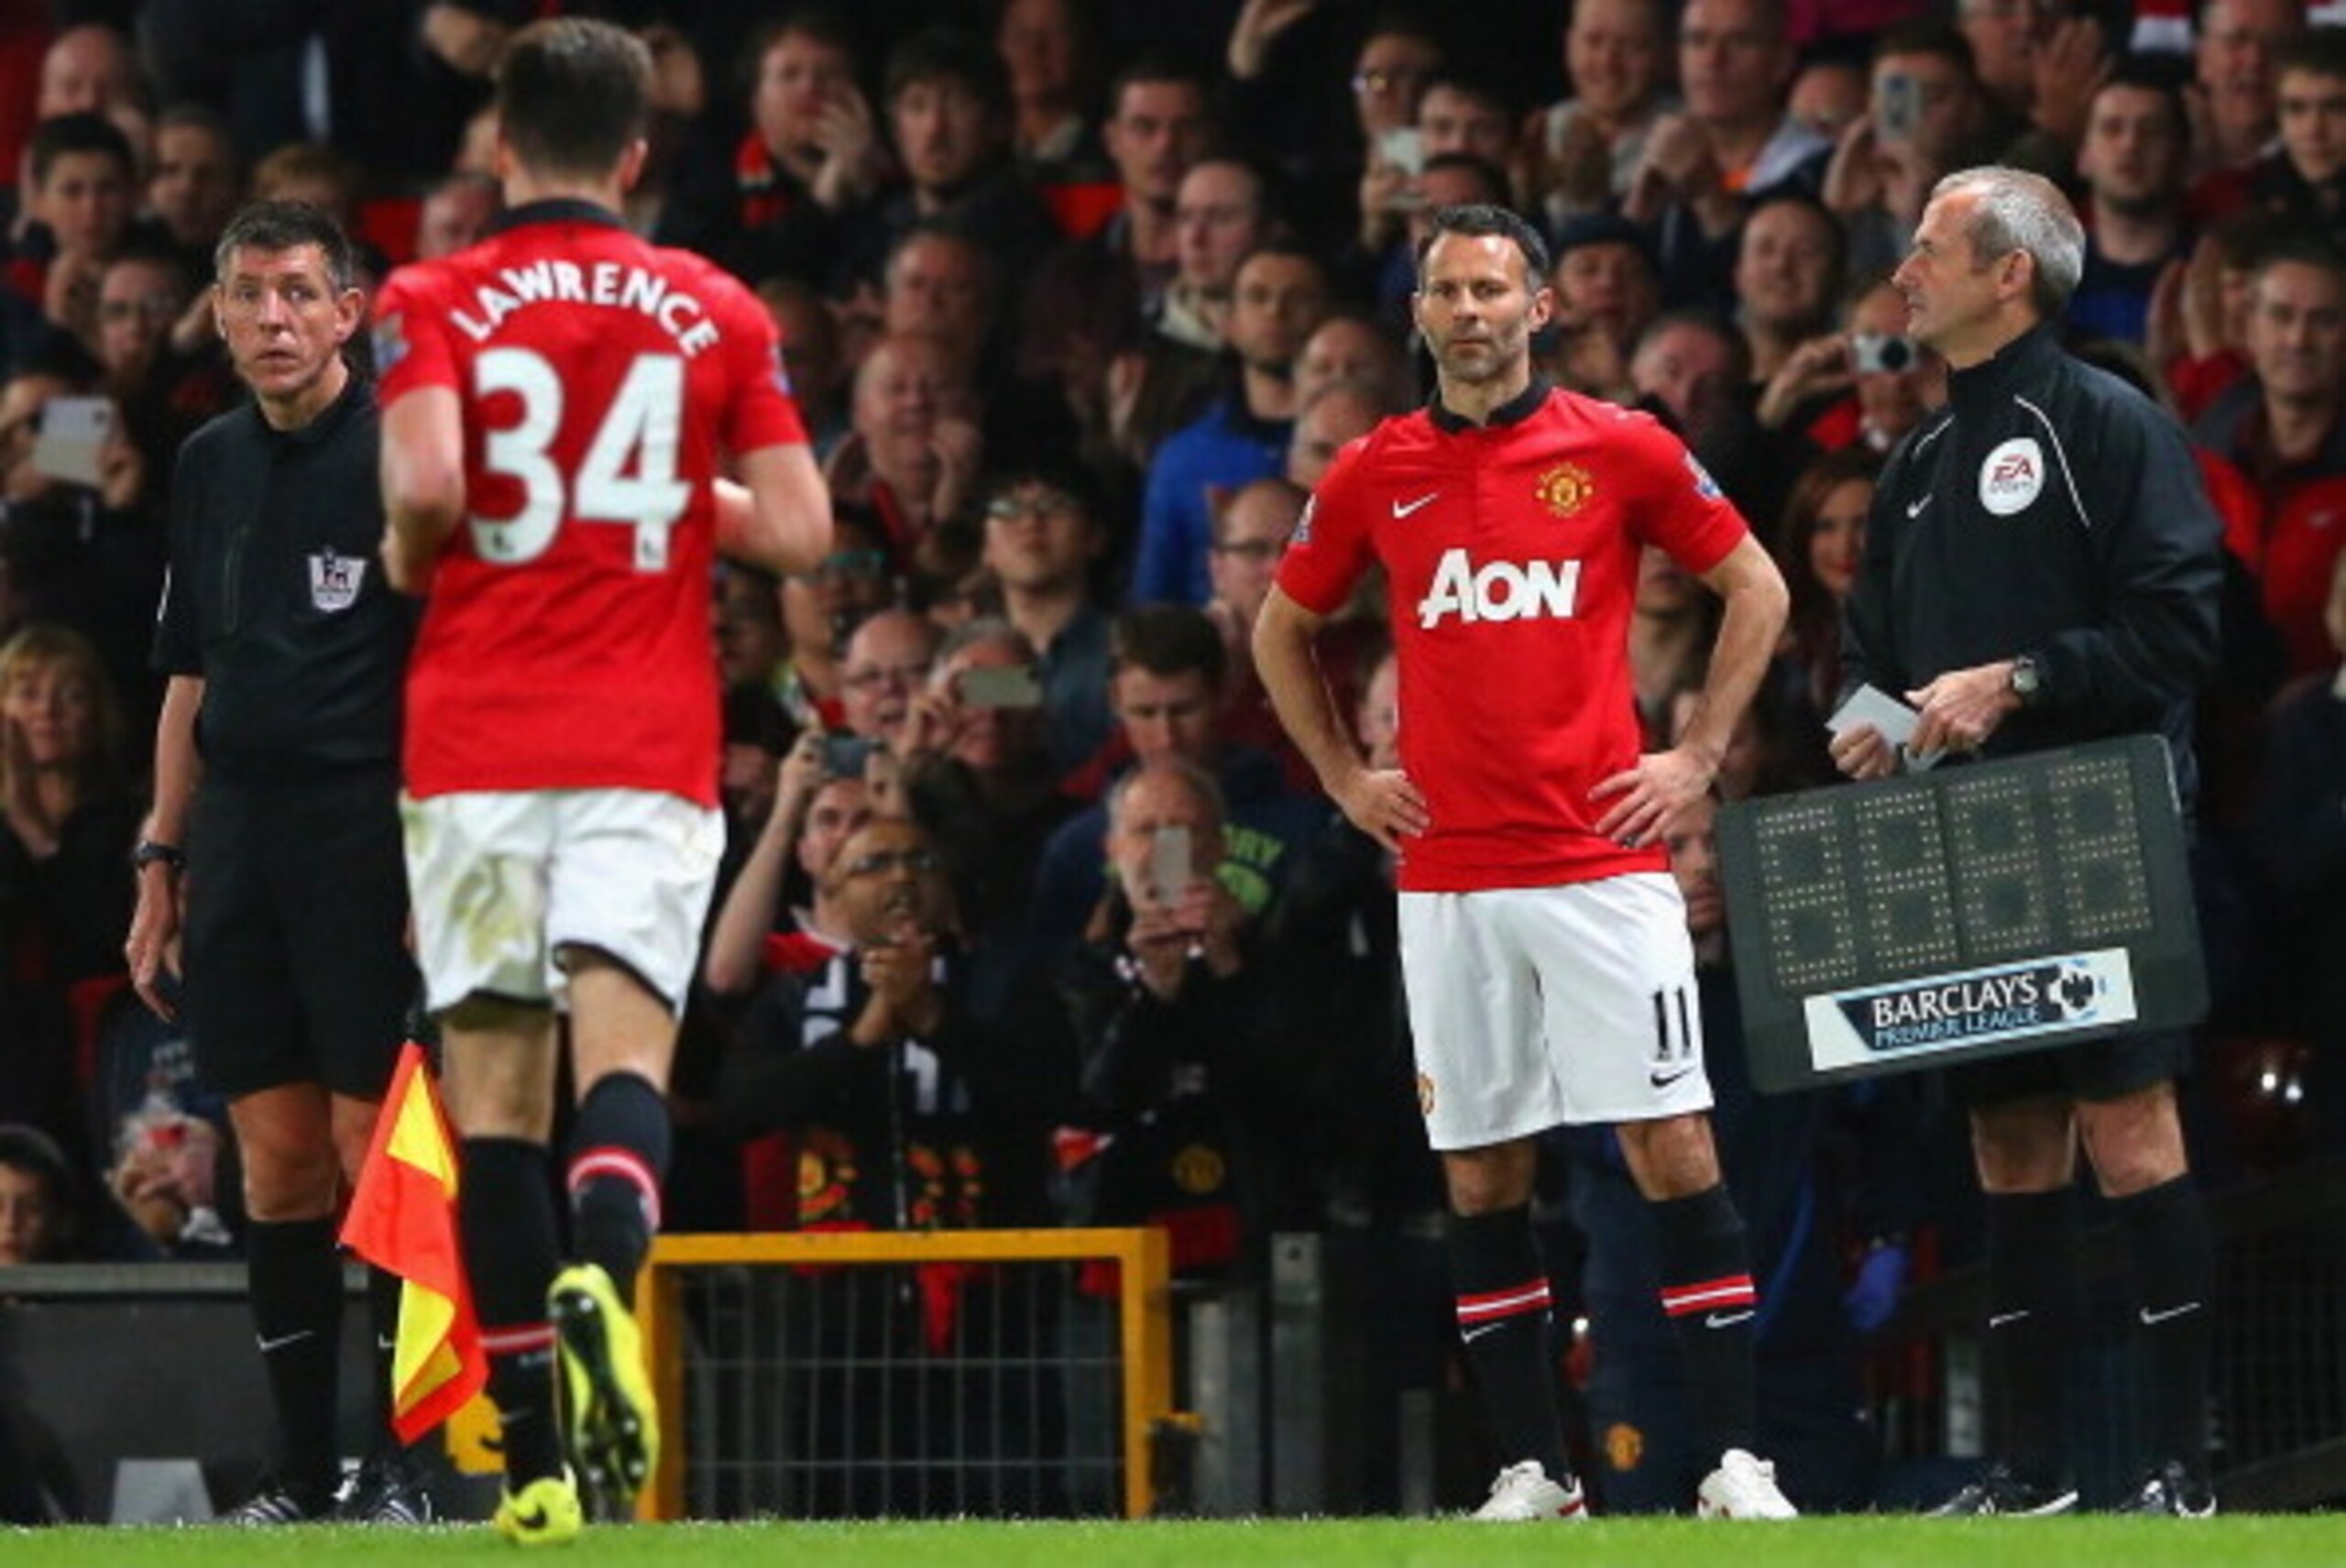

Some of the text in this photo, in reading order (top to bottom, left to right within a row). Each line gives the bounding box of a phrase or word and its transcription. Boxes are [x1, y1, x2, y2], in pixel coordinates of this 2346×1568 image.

[450, 259, 720, 356] LAWRENCE
[470, 345, 693, 572] 34
[1993, 454, 2035, 482] EA
[1650, 985, 1691, 1063] 11
[1871, 971, 2039, 1028] BARCLAYS
[1874, 1003, 2040, 1047] PREMIER LEAGUE
